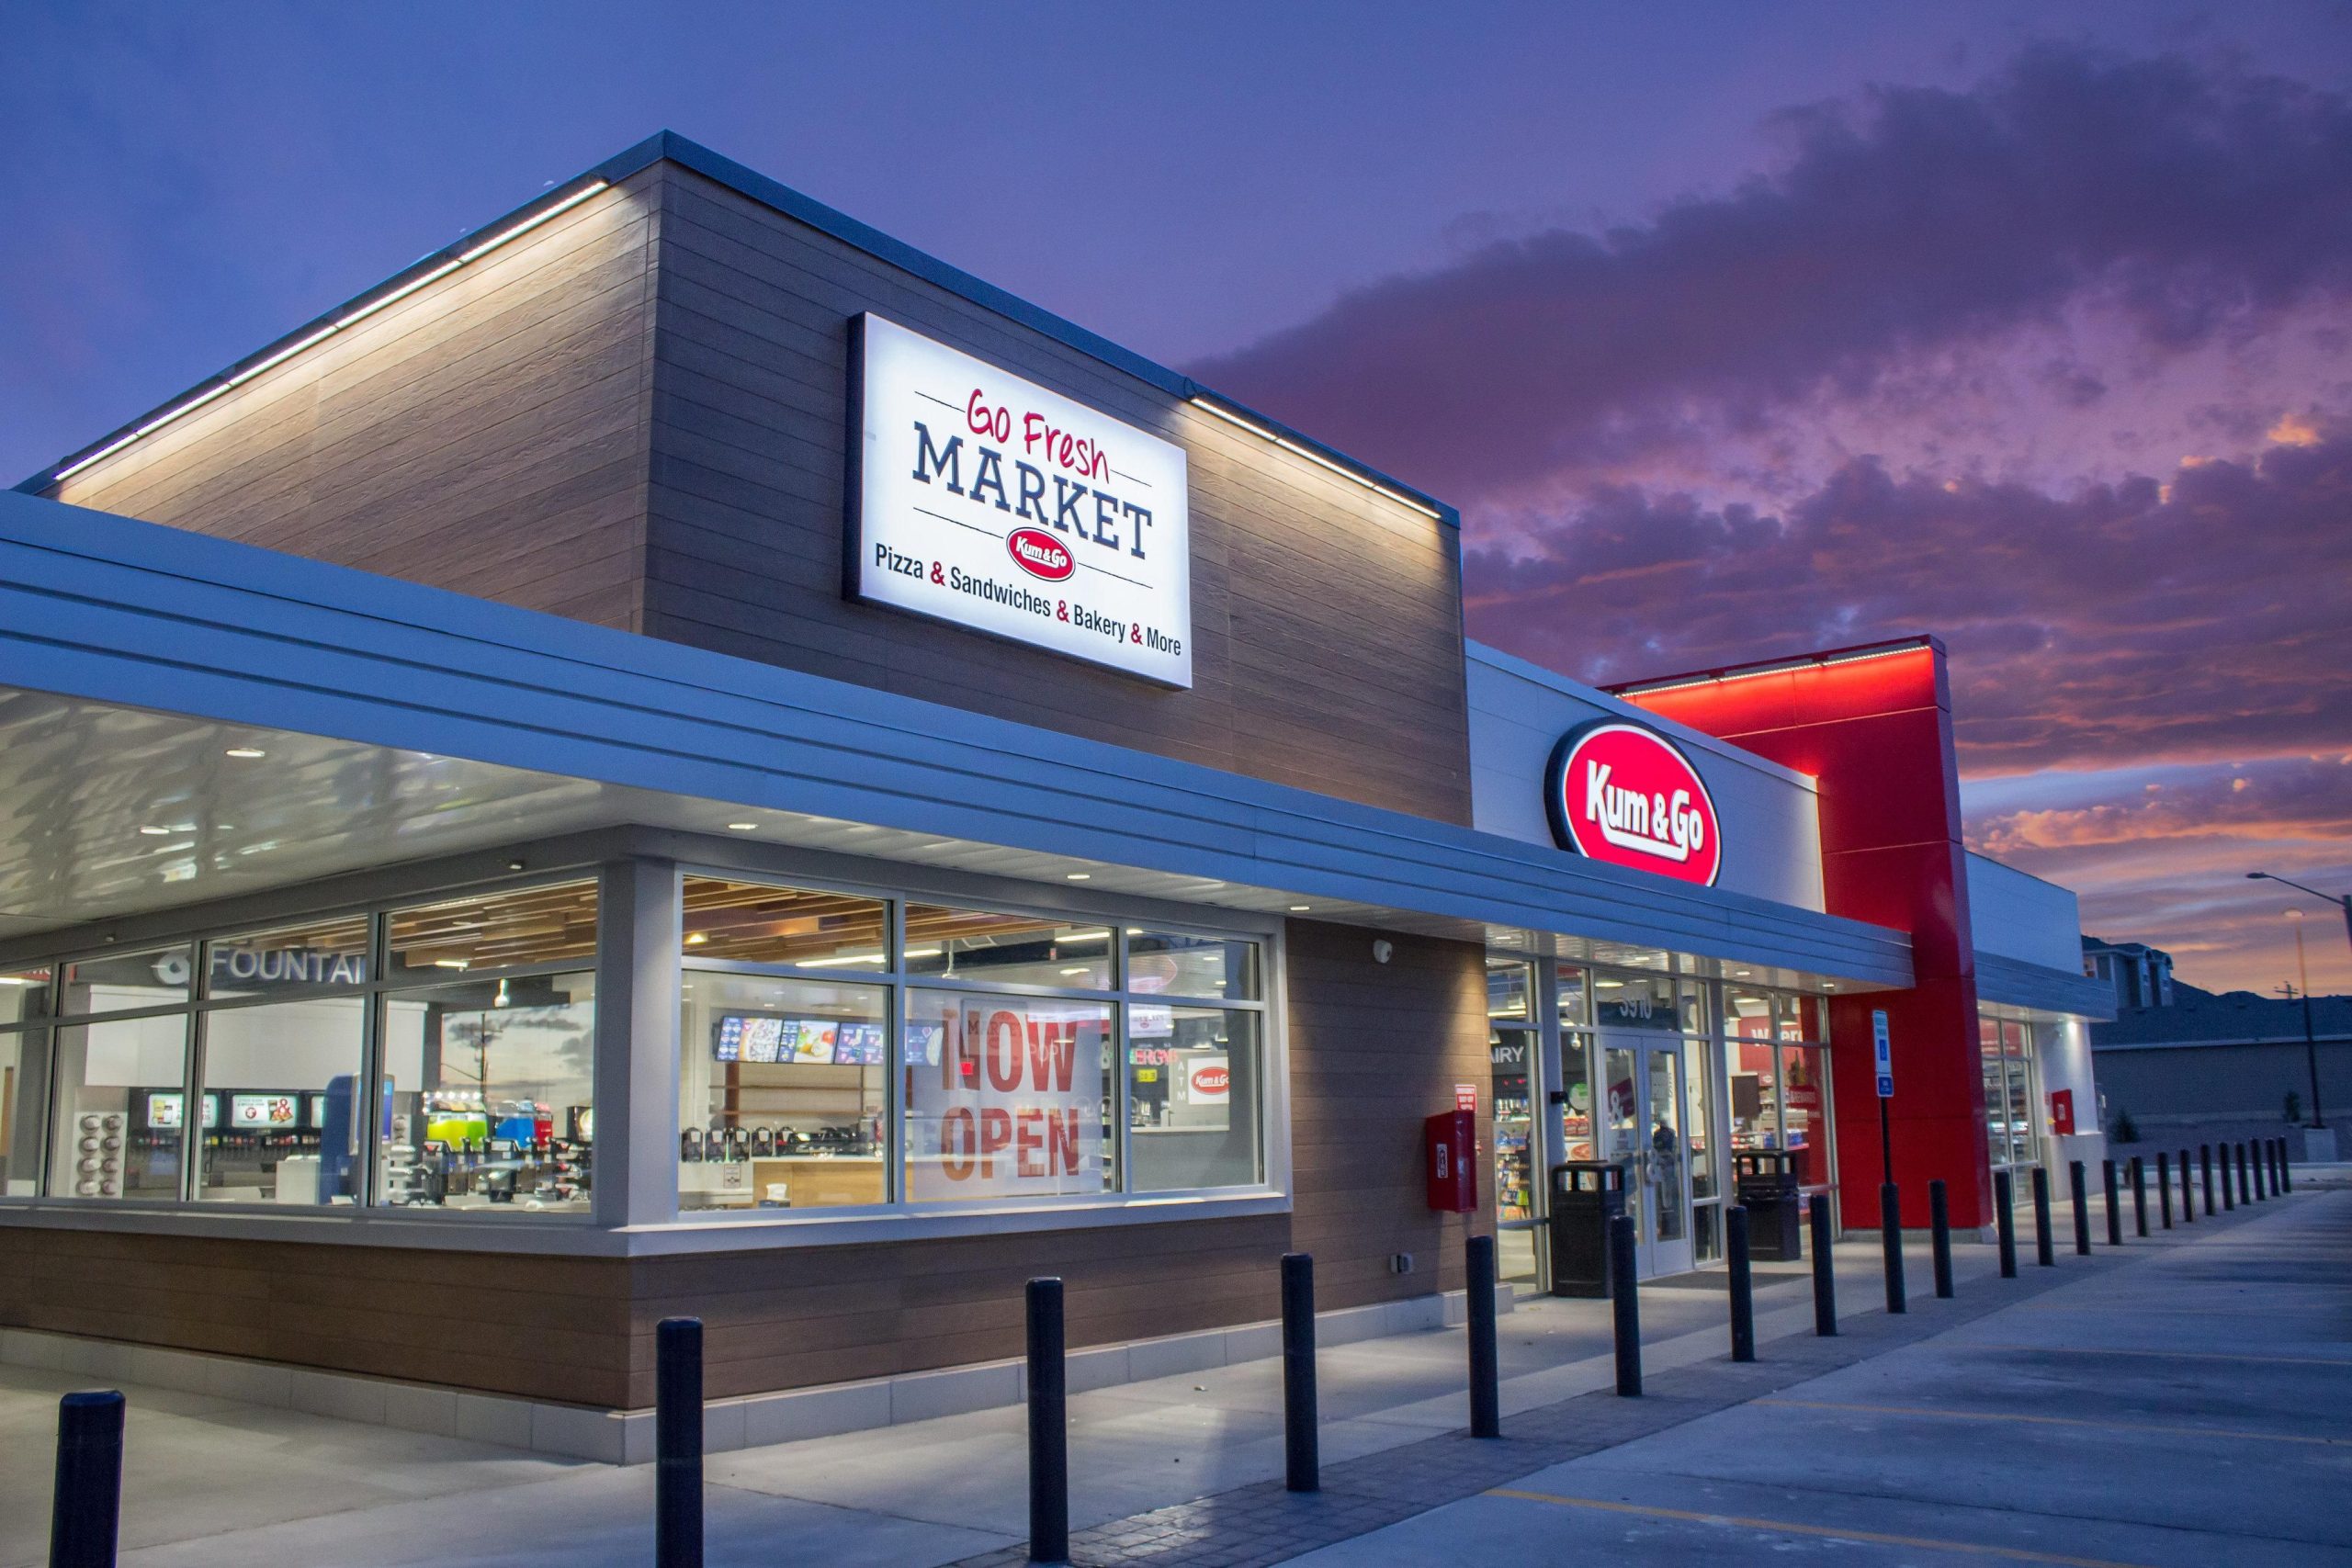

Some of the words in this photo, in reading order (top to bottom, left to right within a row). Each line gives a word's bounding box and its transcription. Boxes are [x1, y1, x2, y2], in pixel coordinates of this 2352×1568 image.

[1023, 411, 1110, 484] Fresh
[912, 421, 1152, 559] MARKET
[876, 542, 923, 580] Pizza
[930, 560, 945, 586] &
[950, 567, 1051, 617] Sandwiches
[1057, 600, 1070, 623] &
[1074, 604, 1126, 644] Bakery
[1130, 623, 1143, 645] &
[1147, 626, 1182, 656] More
[209, 947, 361, 985] FOUNTAI
[942, 1009, 1078, 1093] NOW
[941, 1106, 1080, 1182] OPEN
